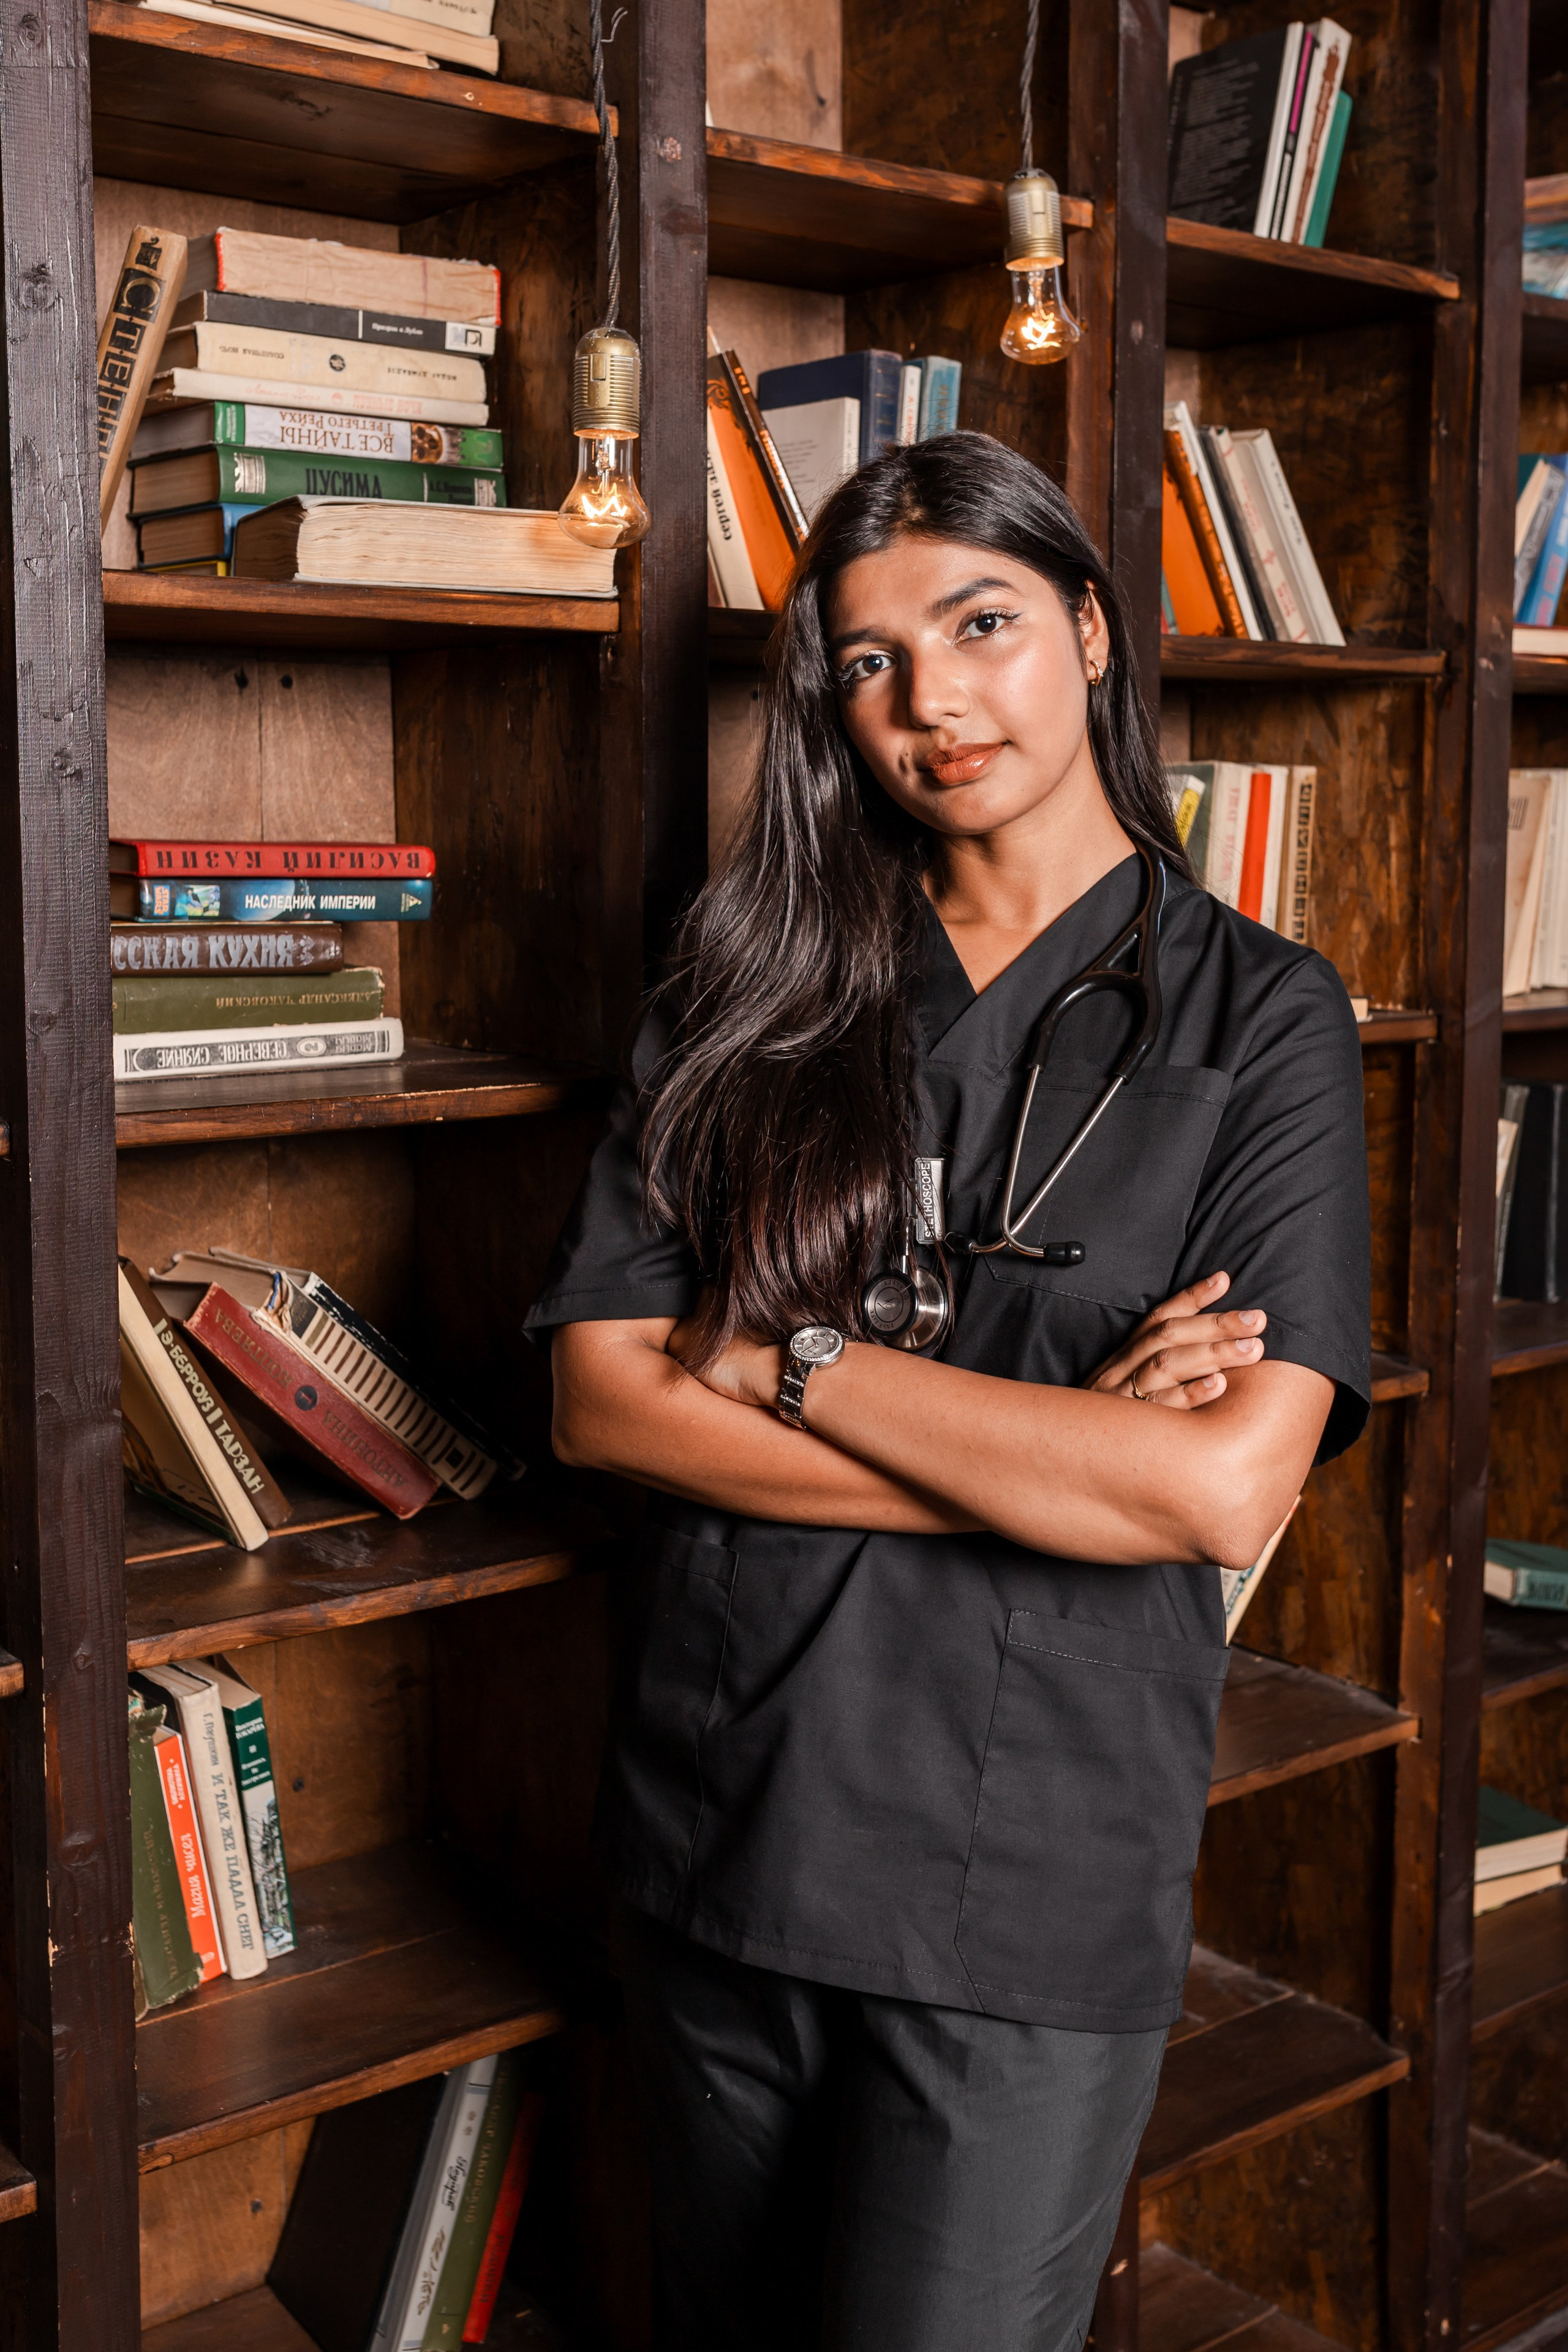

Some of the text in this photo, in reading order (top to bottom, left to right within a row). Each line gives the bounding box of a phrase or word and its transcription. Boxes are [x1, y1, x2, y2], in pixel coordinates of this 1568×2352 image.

[279, 425, 394, 454] ВСЕ ТАЙНЫ
[305, 467, 383, 498] ЦУСИМА
[157, 850, 420, 873] ВАСИЛИЙ КАЗИН
[154, 886, 164, 915] WARS
[162, 886, 170, 913] STAR
[244, 894, 376, 910] НАСЛЕДНИК ИМПЕРИИ
[110, 933, 295, 971] ССКАЯ КУХНЯ
[215, 991, 371, 1009] АЛЕКСАНДР ЧАКОВСКИЙ
[156, 1041, 288, 1069] СЕВЕРНОЕ СИЯНИЕ
[921, 1163, 933, 1238] STETHOSCOPE
[883, 1279, 910, 1300] QUALITY
[213, 1306, 294, 1393] КОПТЯЕВА
[214, 1418, 266, 1495] ТАРЗАН
[322, 1408, 410, 1490] АНТОНИНА
[184, 1832, 207, 1920] Магия чисел
[212, 1772, 255, 1951] И ТАК ЖЕ ПАДАЛ СНЕГ
